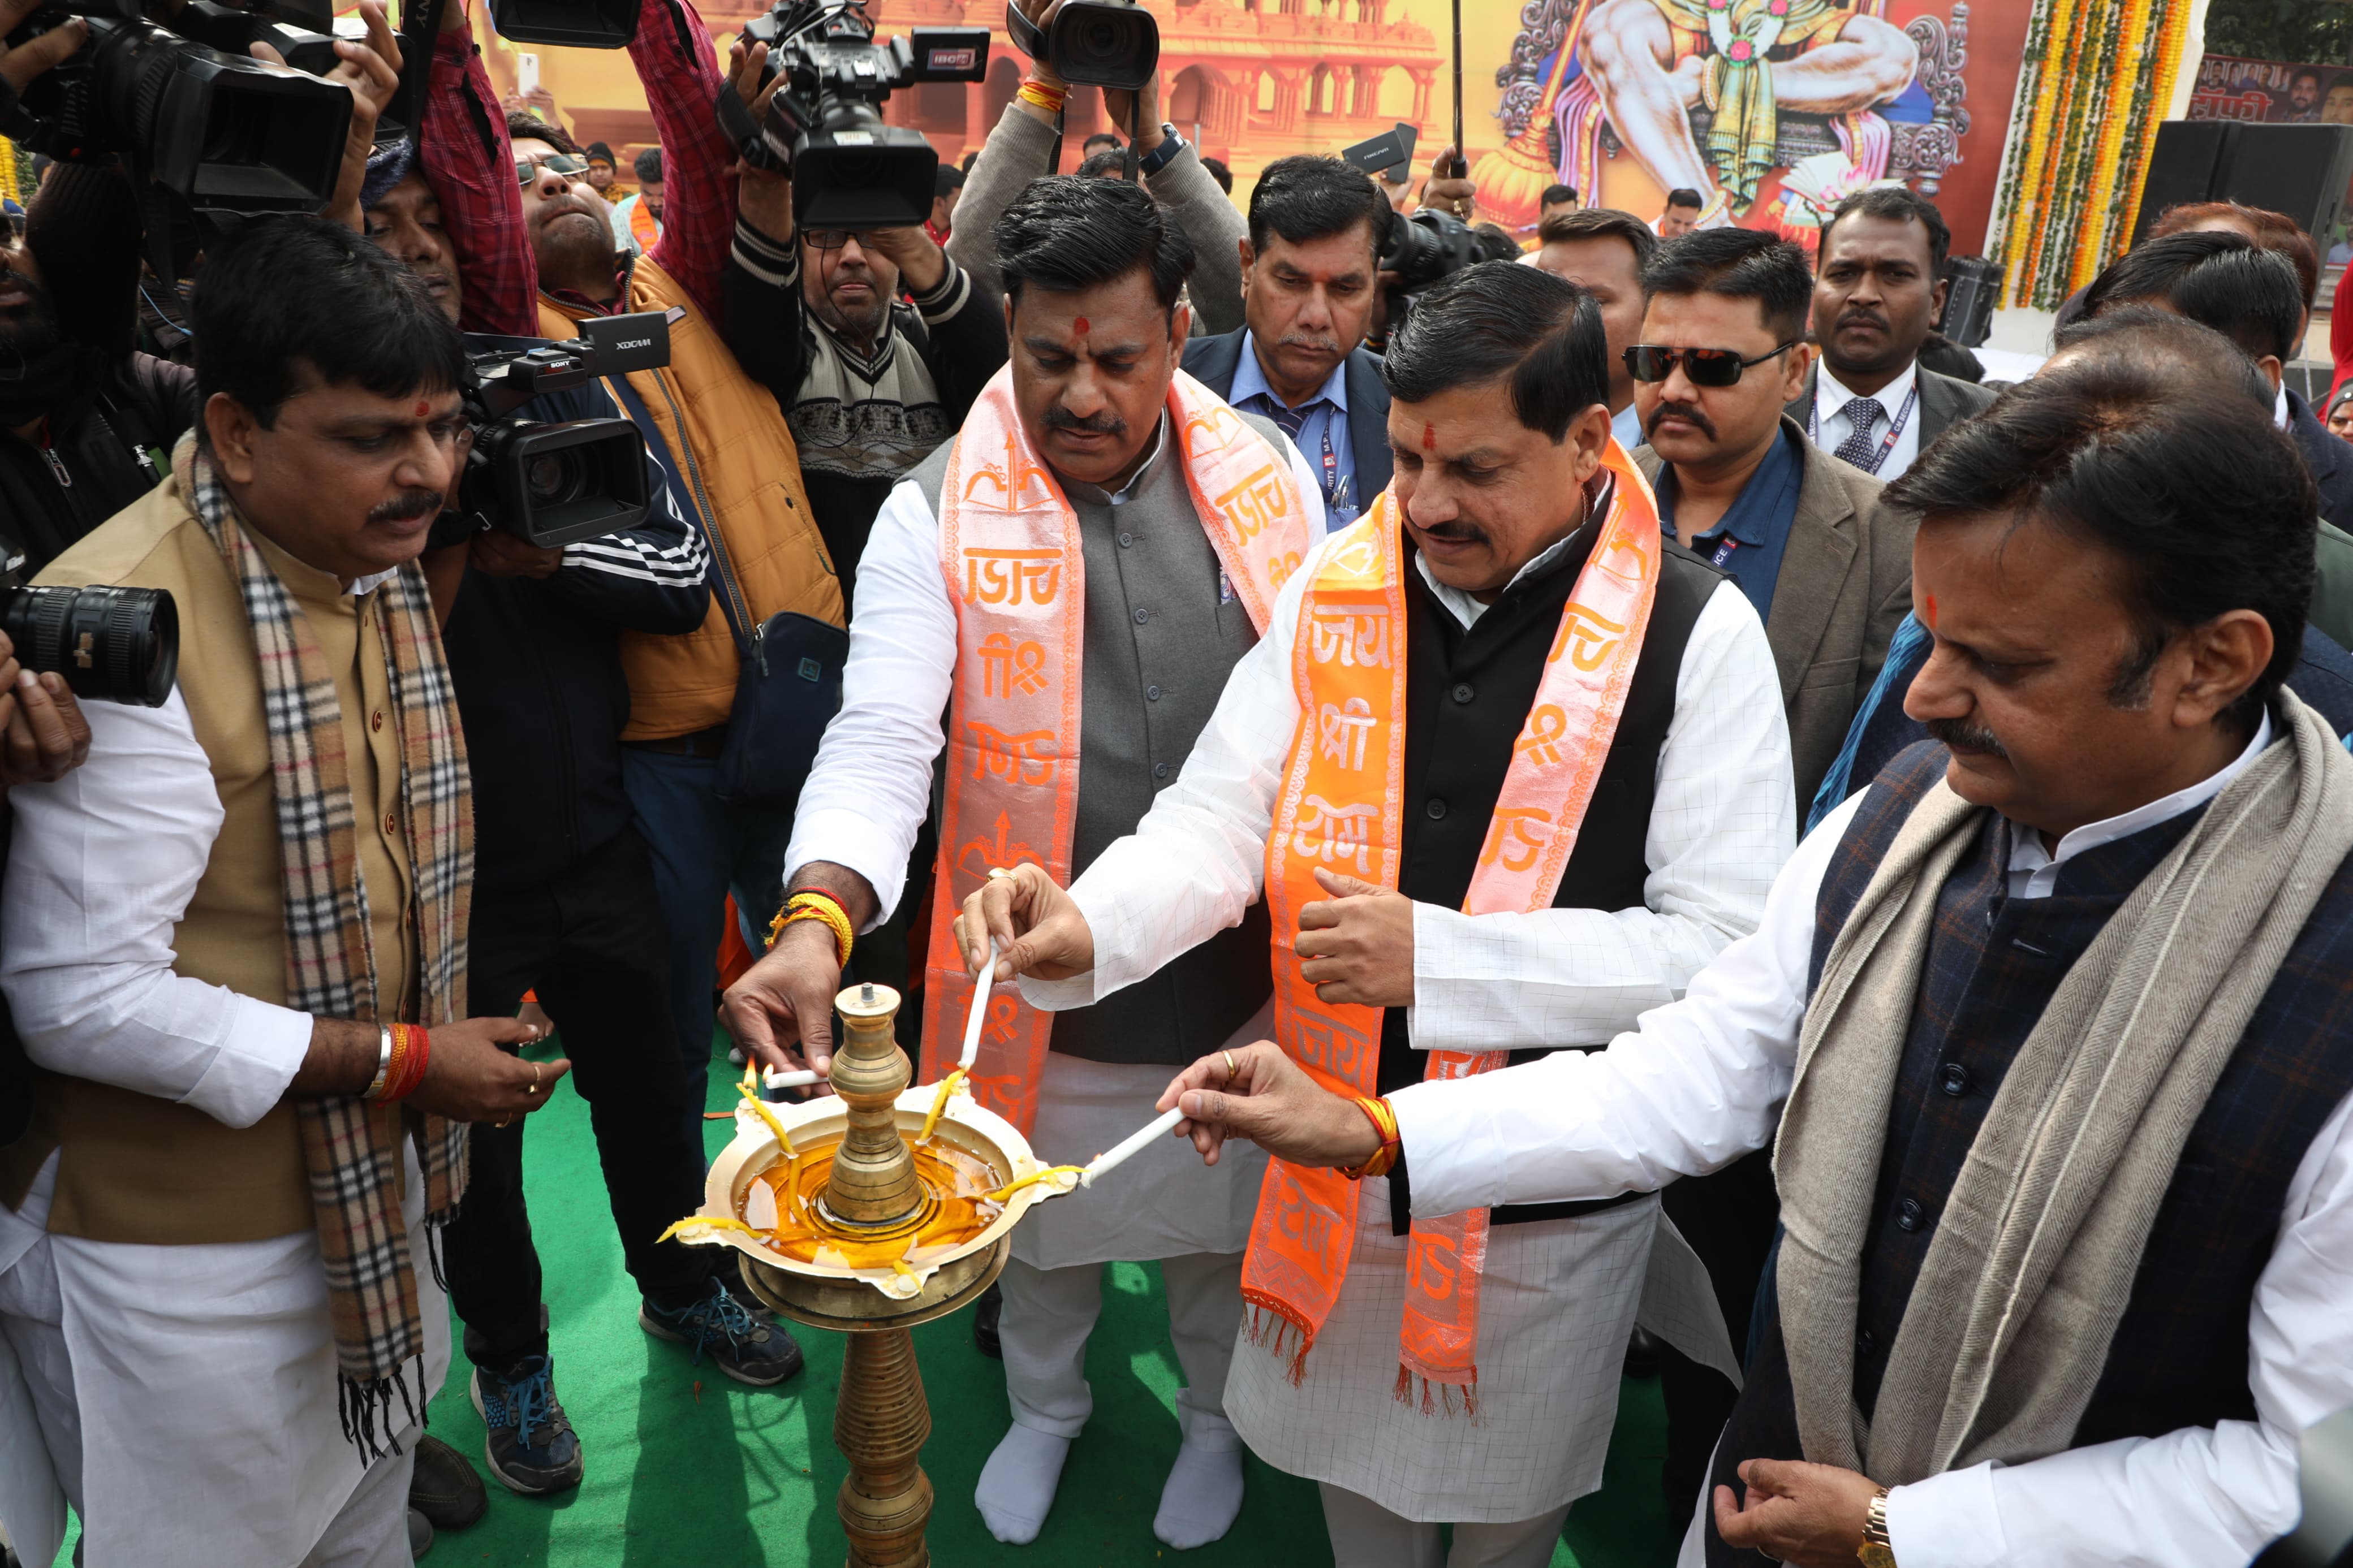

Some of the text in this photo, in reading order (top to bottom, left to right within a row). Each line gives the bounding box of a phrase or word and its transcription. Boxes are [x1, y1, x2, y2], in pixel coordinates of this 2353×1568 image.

[616, 339, 651, 350] XDCAM
[1894, 394, 1914, 432] CM SECURITY
[1869, 447, 1888, 474] POLICE
[1313, 605, 1393, 669] जय
[1319, 697, 1377, 771] श्री
[1293, 794, 1379, 875] राम
[1294, 1005, 1369, 1094] जय
[1278, 1176, 1343, 1275] राम
